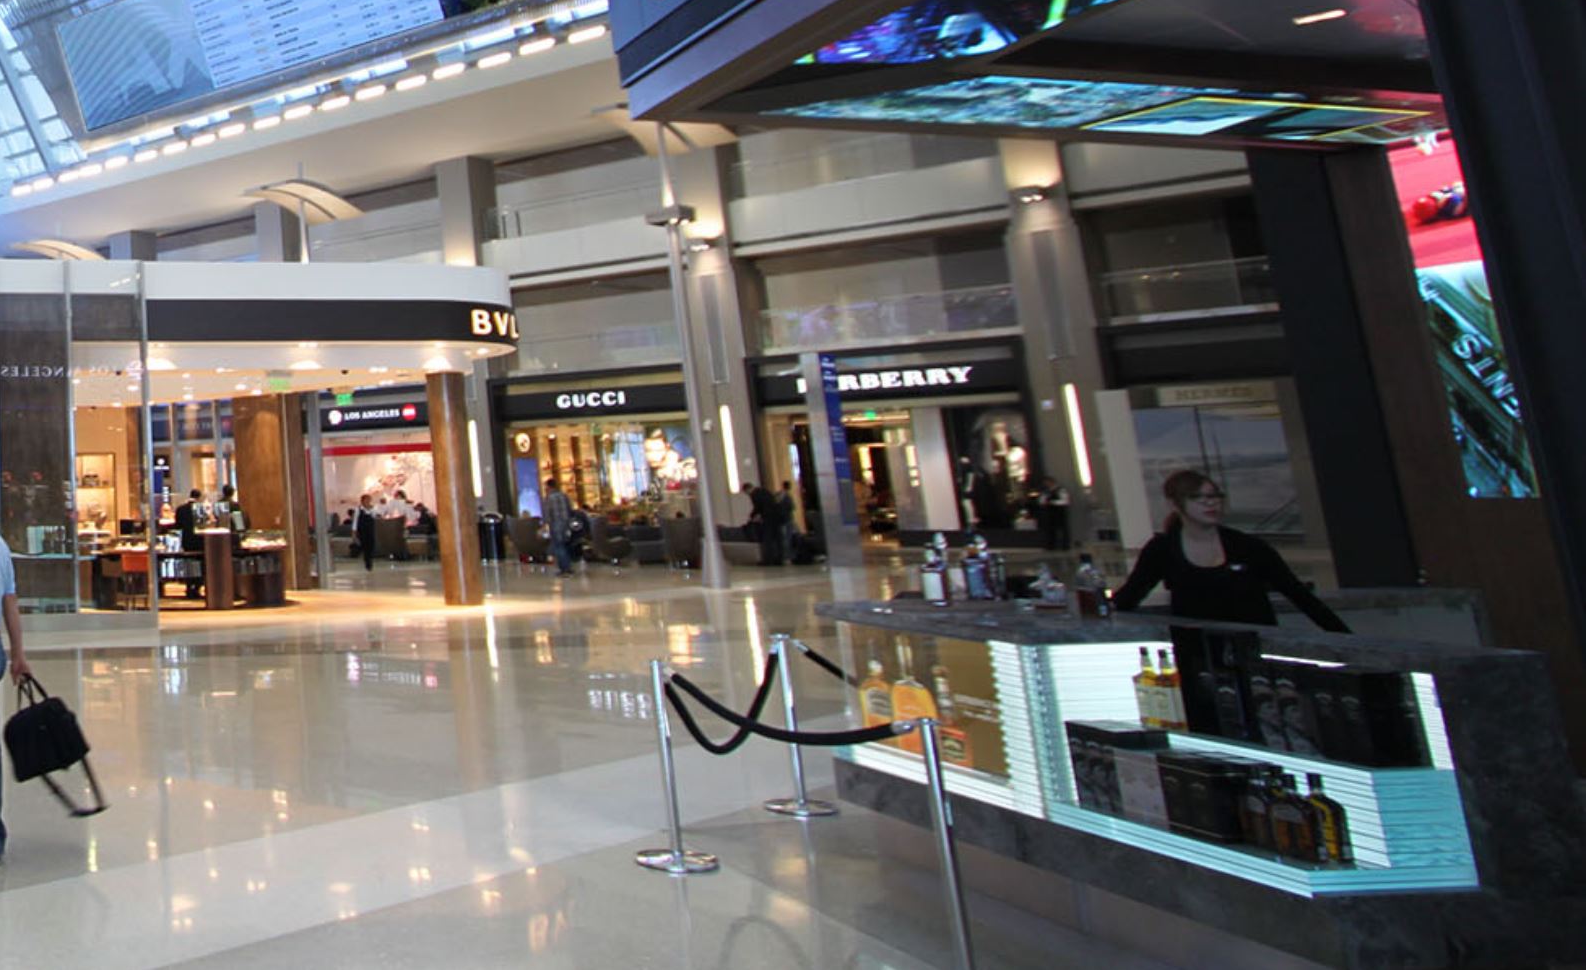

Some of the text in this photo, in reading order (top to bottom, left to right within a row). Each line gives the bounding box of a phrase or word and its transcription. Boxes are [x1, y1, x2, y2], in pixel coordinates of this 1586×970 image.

[796, 366, 973, 393] RBERRY
[556, 391, 626, 409] GUCCI
[344, 412, 360, 420] LOS
